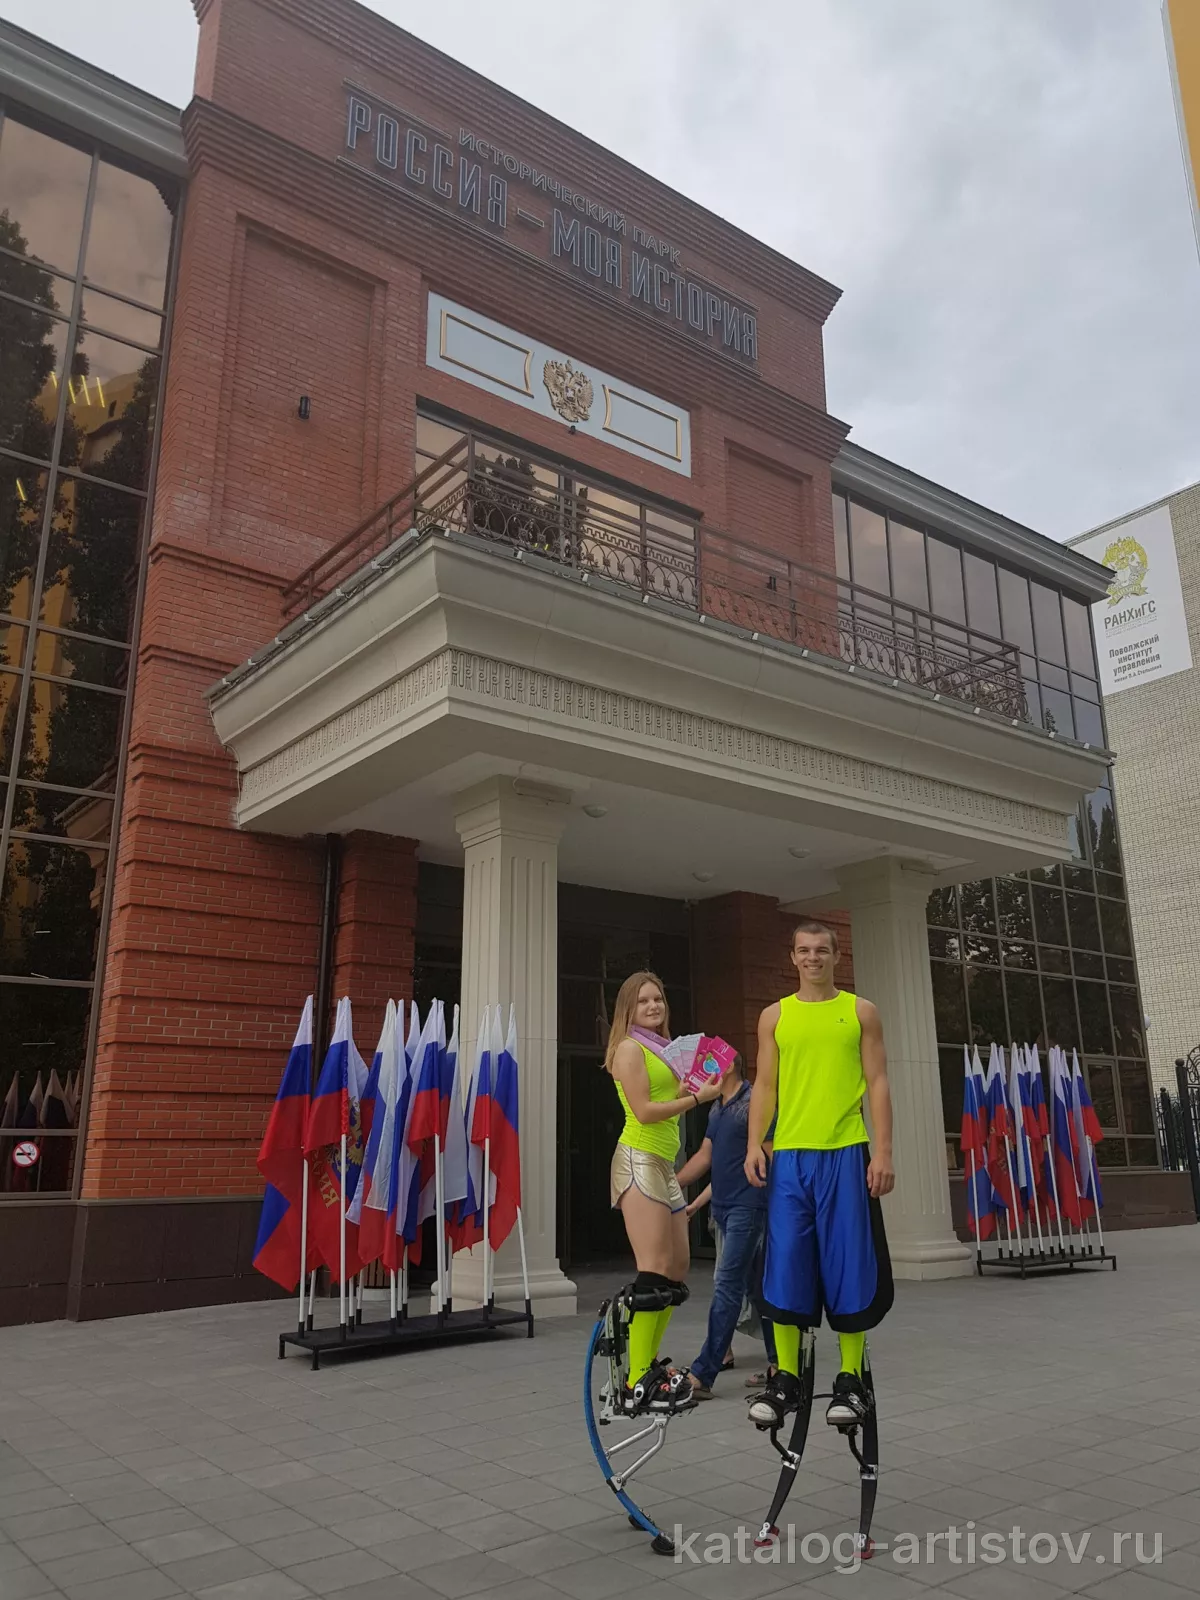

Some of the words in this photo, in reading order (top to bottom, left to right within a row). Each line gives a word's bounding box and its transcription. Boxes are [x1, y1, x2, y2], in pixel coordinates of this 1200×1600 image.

[458, 127, 627, 236] ИСТОРИЧЕСКИЙ
[633, 226, 682, 267] ПАРК
[347, 95, 508, 228] РОССИЯ
[552, 208, 623, 289] МОЯ
[631, 250, 759, 360] ИСТОРИЯ
[1104, 600, 1156, 629] РАНХиГС
[1109, 634, 1160, 658] Поволжский
[1117, 646, 1153, 664] институт
[1113, 653, 1161, 676] управления
